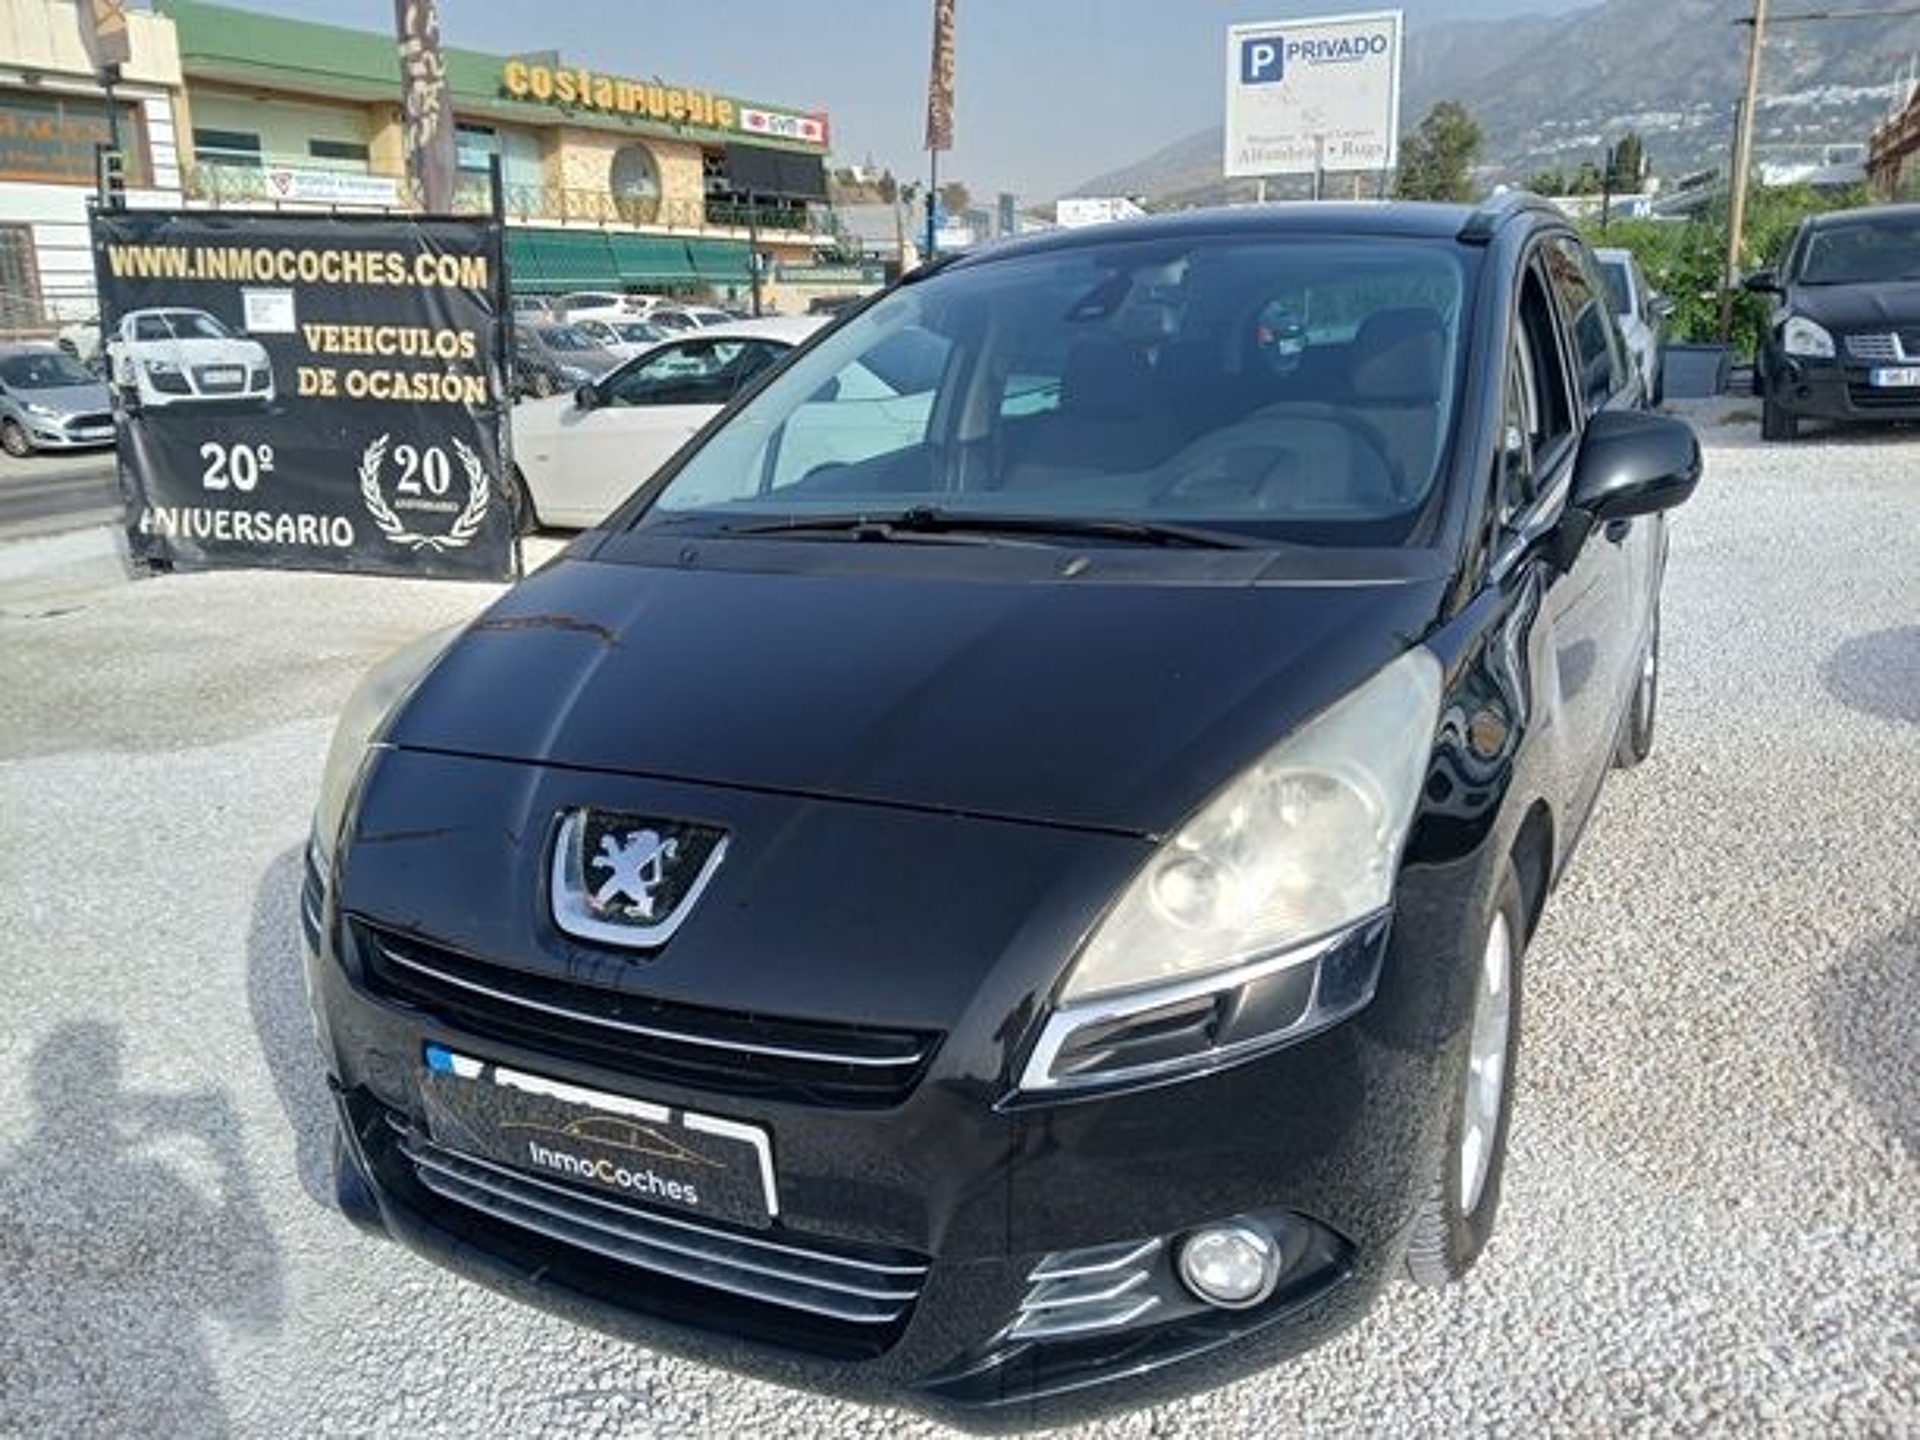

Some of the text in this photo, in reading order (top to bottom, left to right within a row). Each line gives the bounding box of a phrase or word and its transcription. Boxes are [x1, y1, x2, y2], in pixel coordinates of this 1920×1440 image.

[1251, 45, 1275, 77] P
[1287, 34, 1388, 60] PRIVADO
[504, 60, 733, 127] costamueble
[108, 244, 488, 290] WWW.INMOCOCHES.COM
[302, 323, 477, 359] VEHICULOS
[297, 363, 488, 404] DE OCASIÓN
[394, 445, 451, 496] 20
[529, 1140, 698, 1204] InmoCoches
